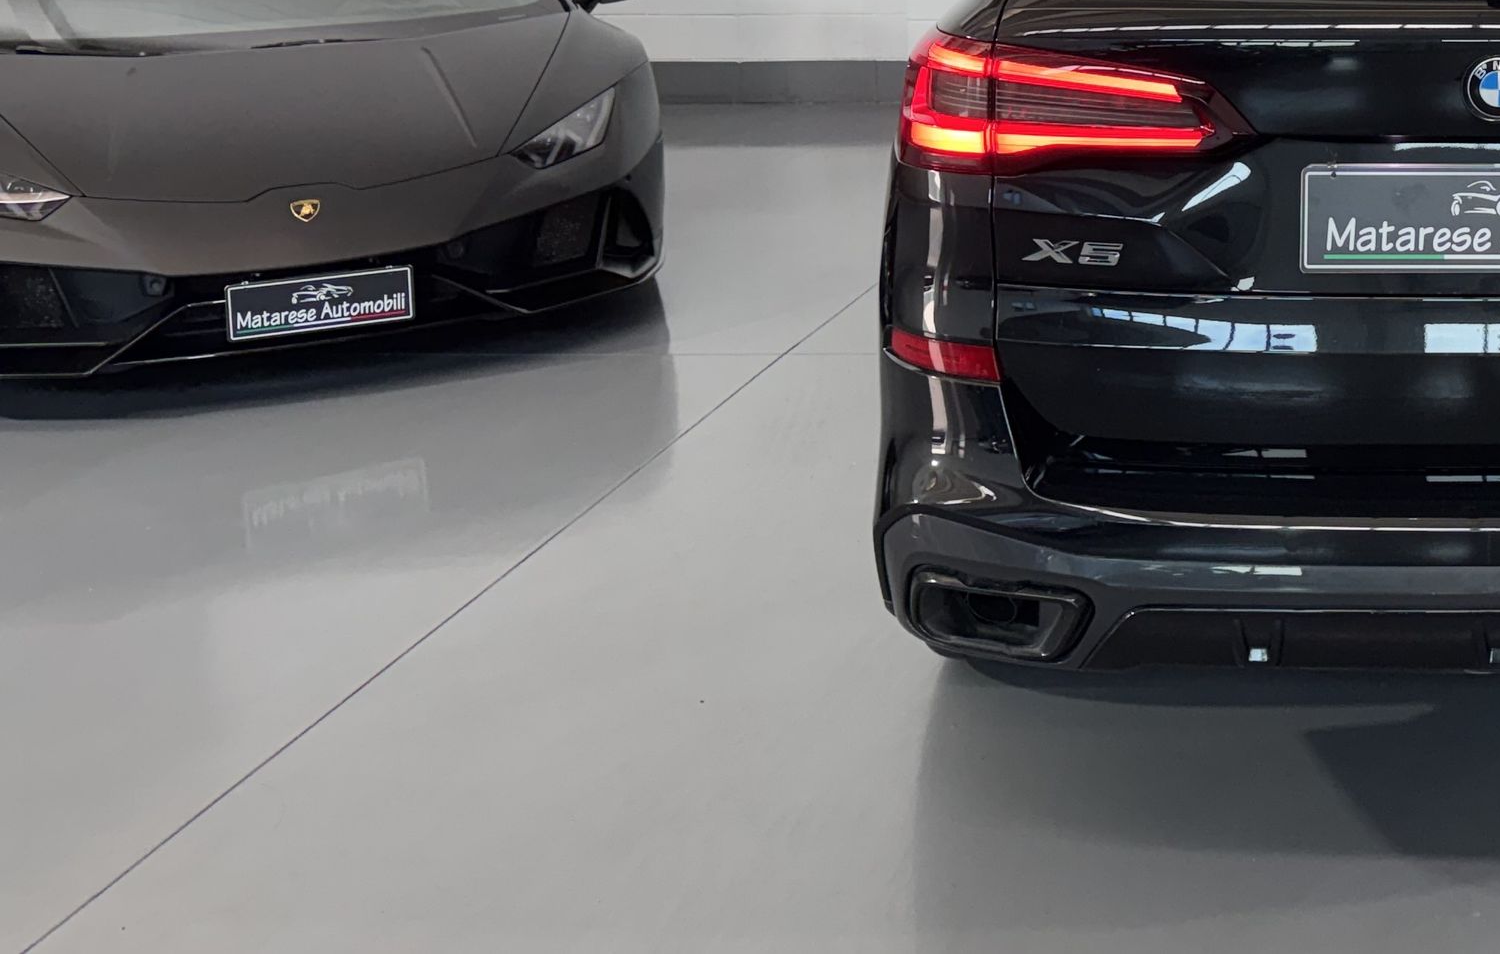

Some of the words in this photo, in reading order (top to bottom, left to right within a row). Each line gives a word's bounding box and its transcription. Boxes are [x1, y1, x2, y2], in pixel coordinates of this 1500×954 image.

[1021, 238, 1124, 266] X5
[1325, 217, 1492, 252] Matarese
[236, 307, 317, 330] Matarese
[320, 292, 406, 319] Automobili
